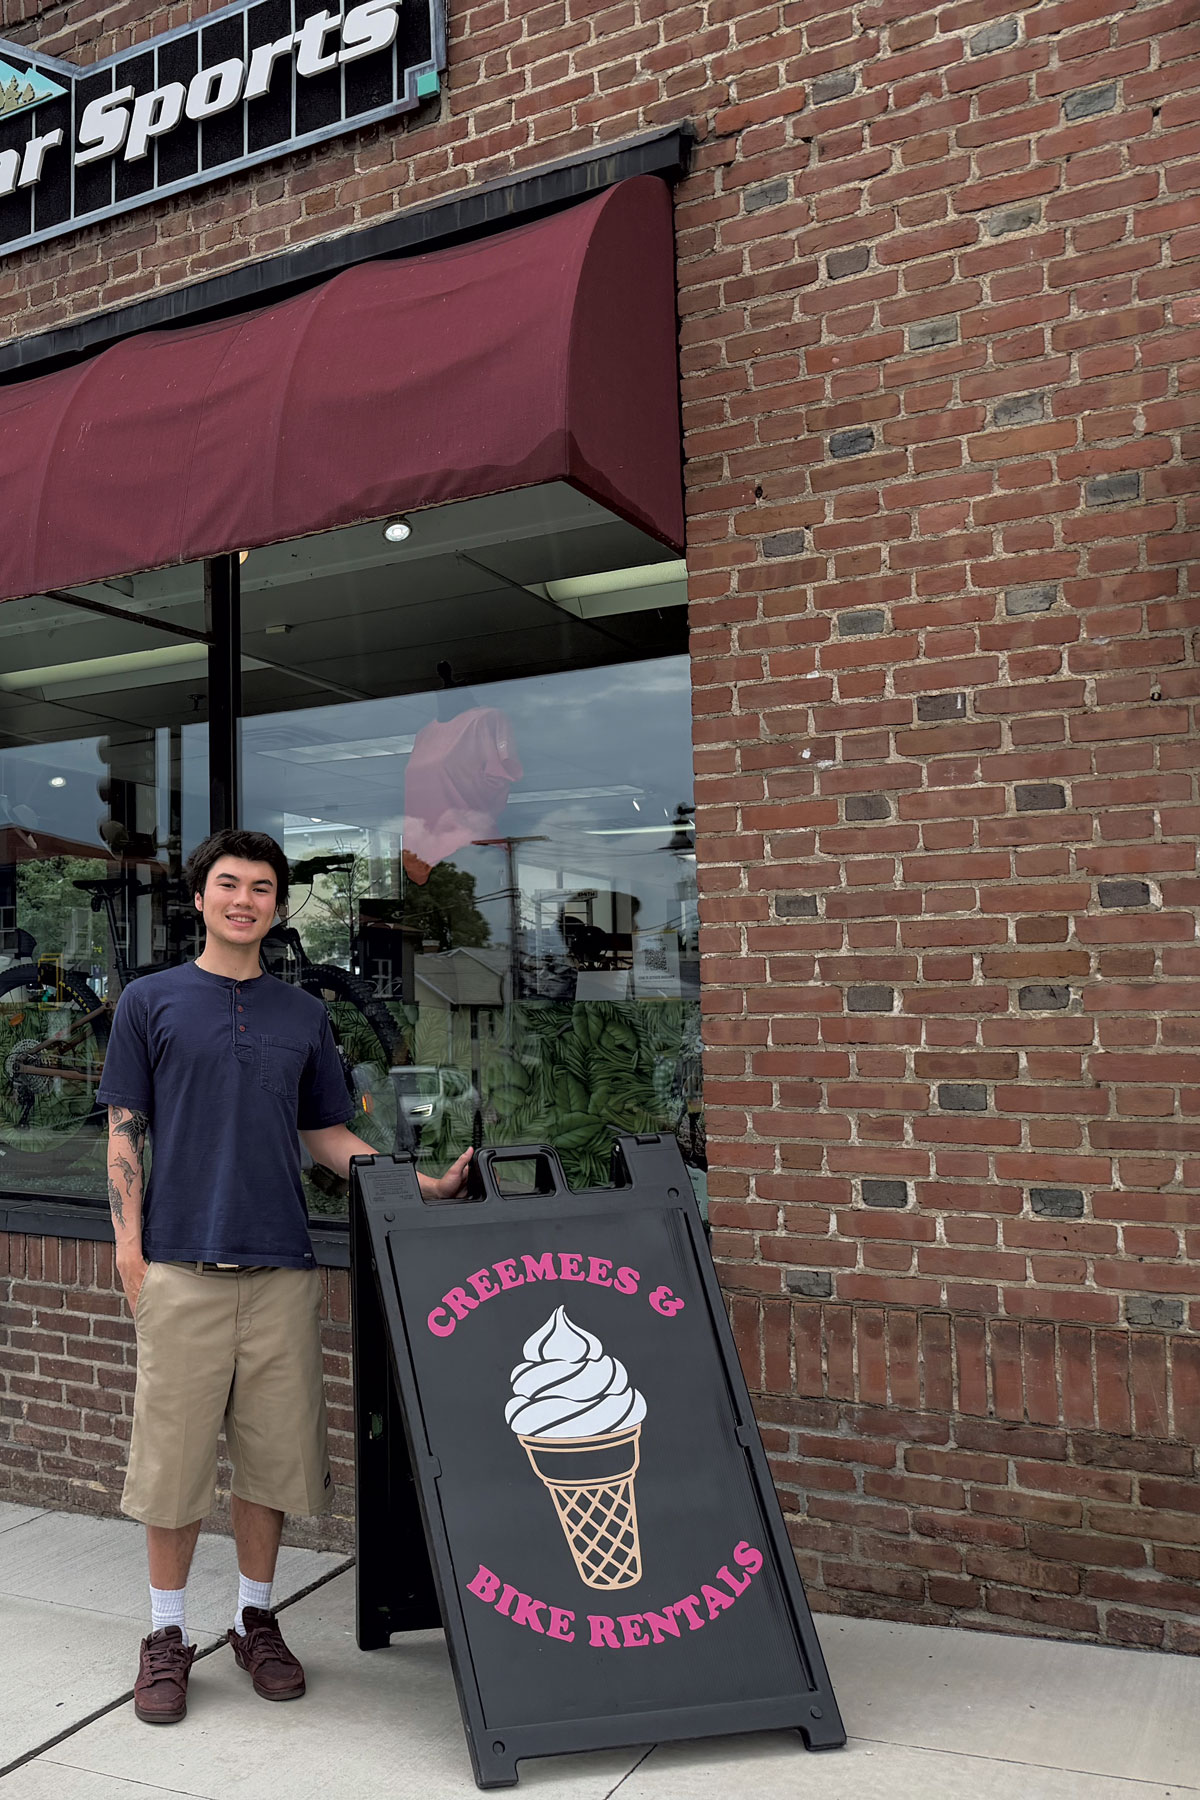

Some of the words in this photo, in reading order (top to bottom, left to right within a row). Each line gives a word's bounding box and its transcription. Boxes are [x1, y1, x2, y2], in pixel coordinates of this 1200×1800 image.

[74, 0, 399, 162] Sports
[427, 1253, 641, 1337] CREEMEES
[649, 1285, 685, 1317] &
[466, 1564, 576, 1643] BIKE
[587, 1540, 764, 1648] RENTALS
